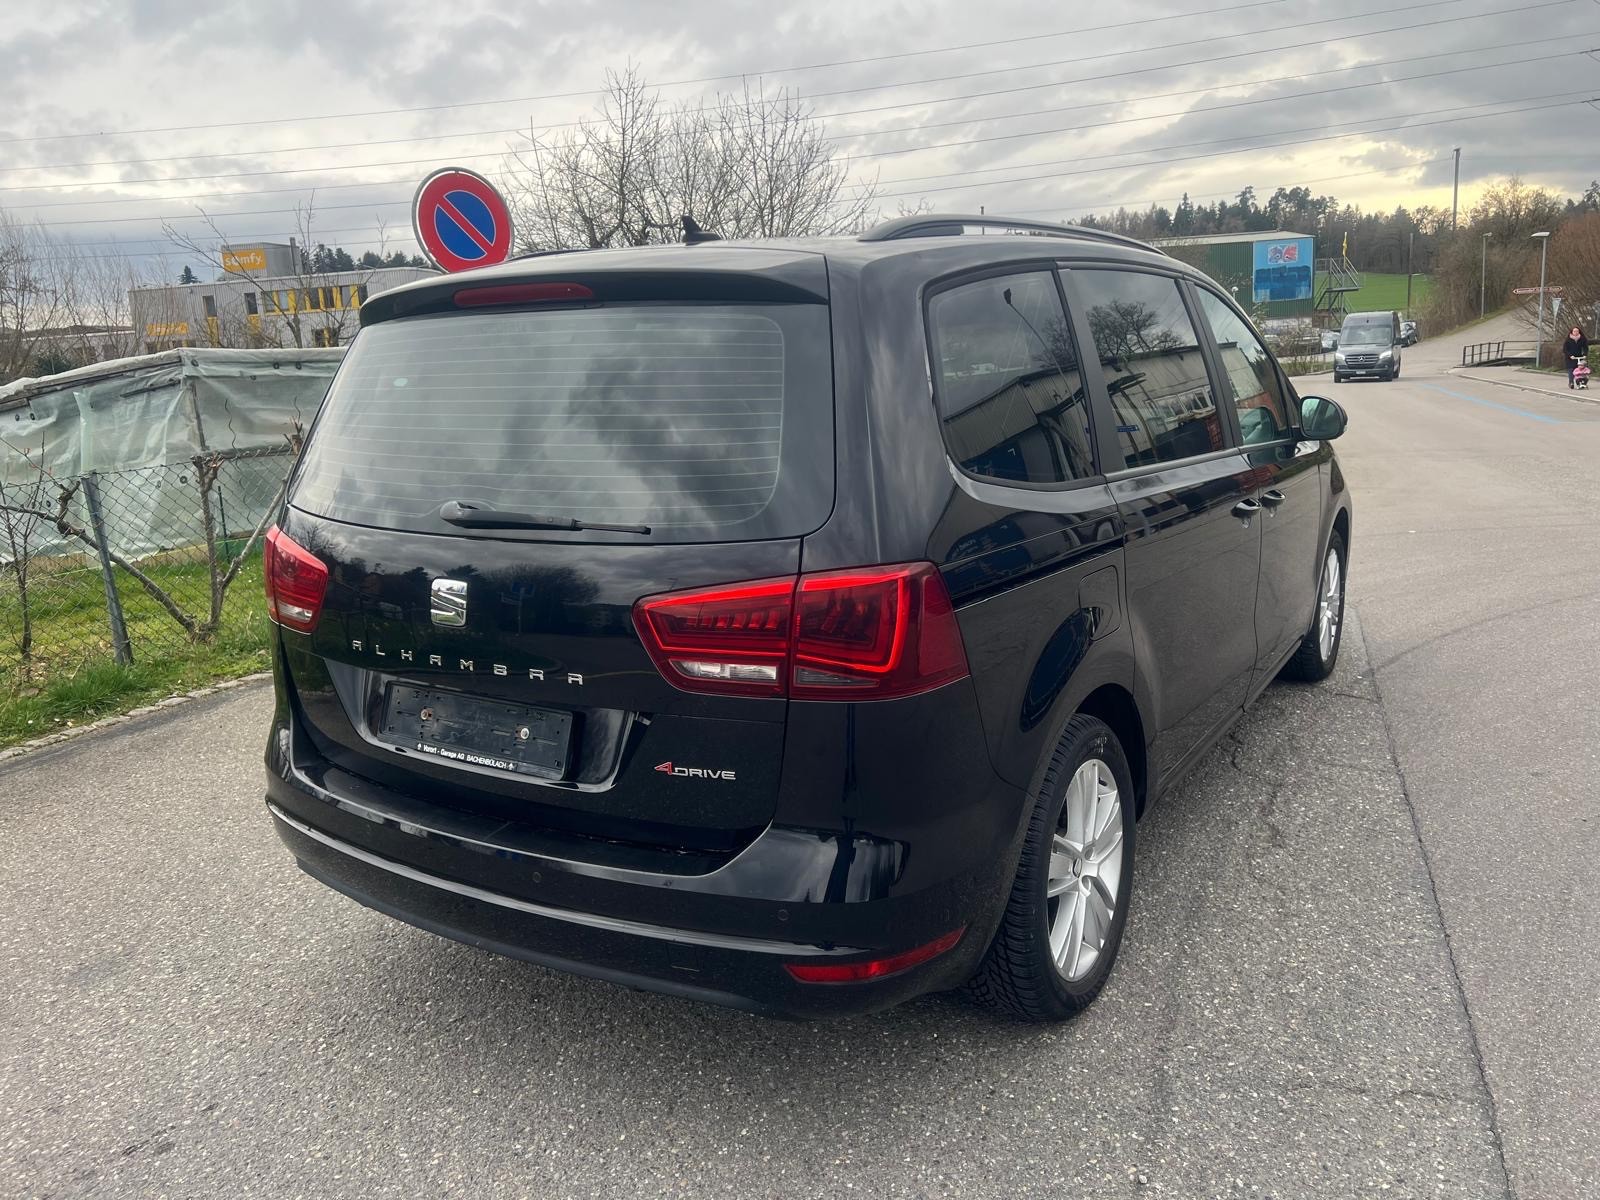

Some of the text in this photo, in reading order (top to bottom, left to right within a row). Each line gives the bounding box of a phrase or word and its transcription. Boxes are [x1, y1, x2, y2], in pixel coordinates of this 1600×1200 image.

[225, 252, 262, 266] somfy
[352, 639, 584, 686] ALHAMBRA
[440, 748, 457, 759] Garage
[457, 752, 465, 760] AG
[654, 761, 736, 780] 4DRIVE
